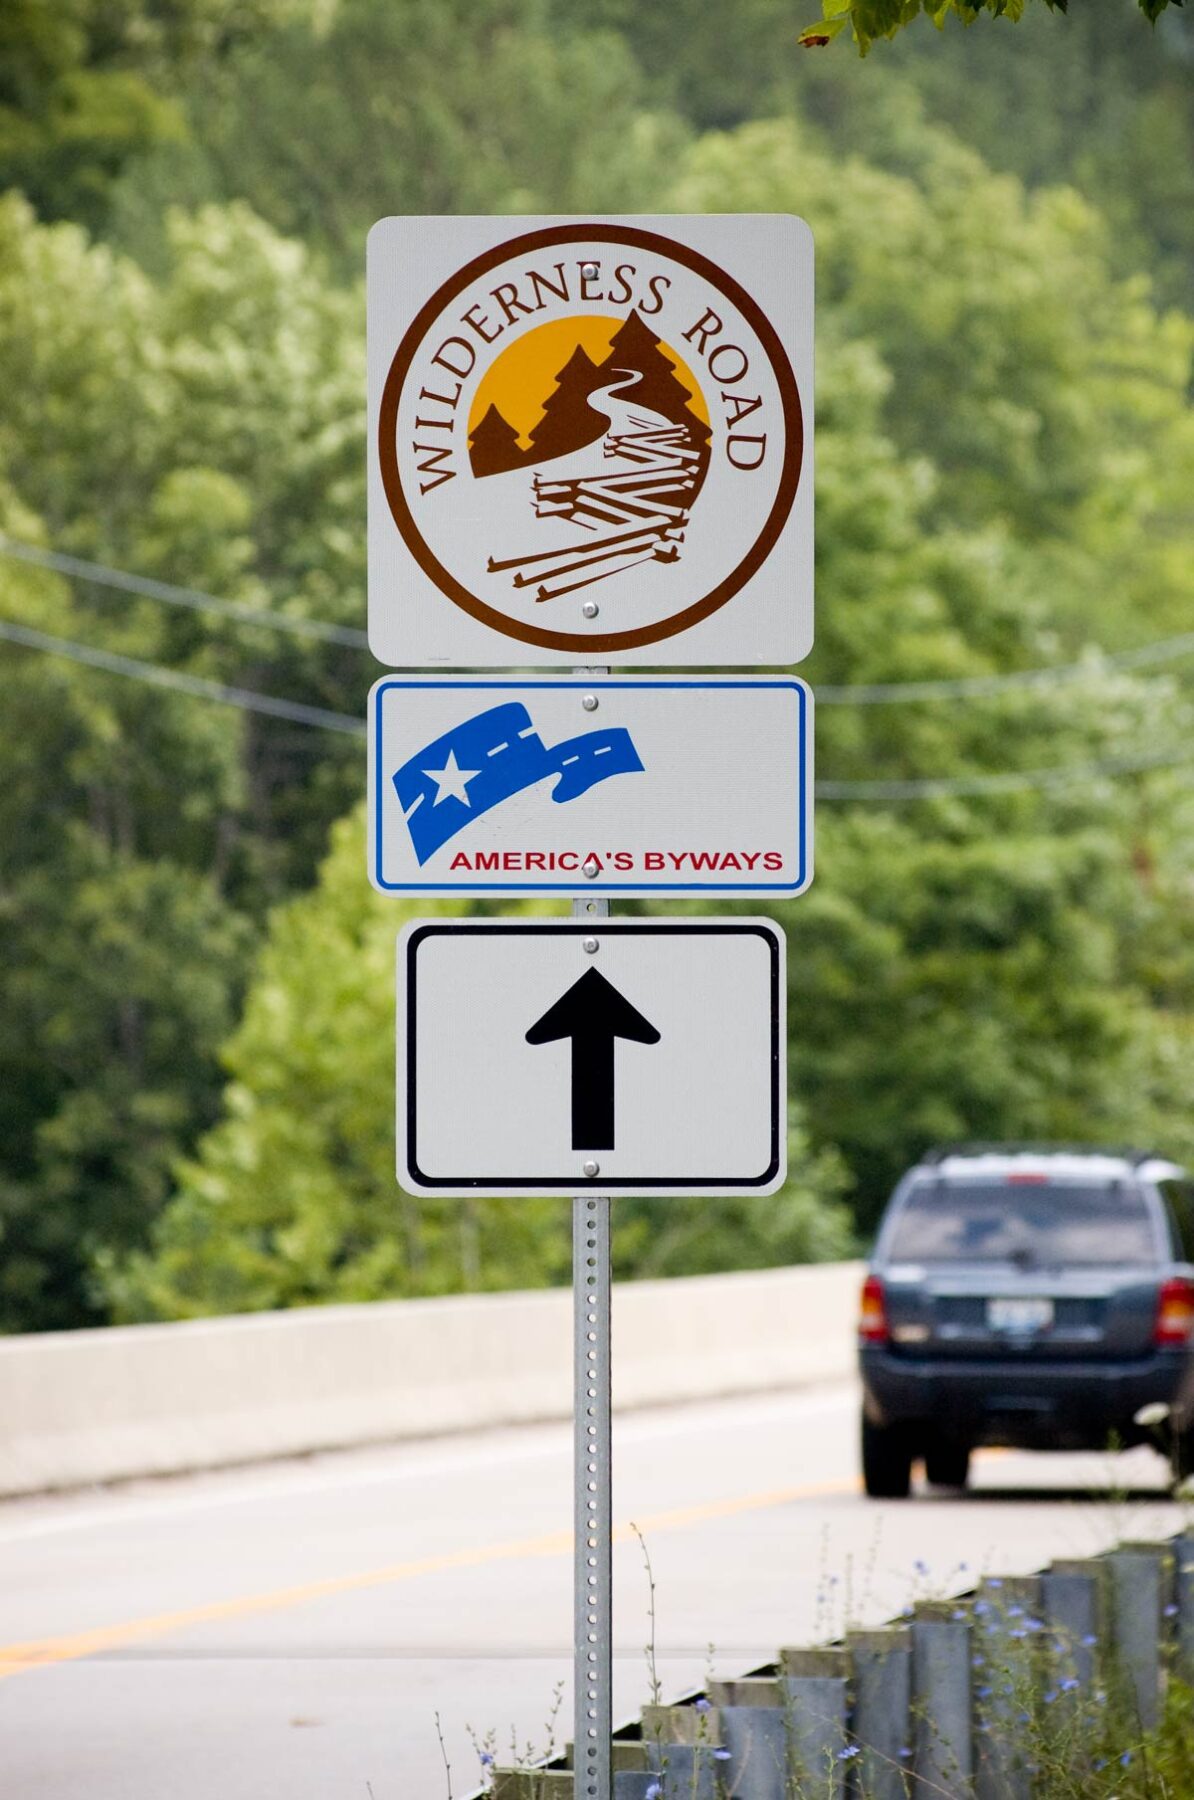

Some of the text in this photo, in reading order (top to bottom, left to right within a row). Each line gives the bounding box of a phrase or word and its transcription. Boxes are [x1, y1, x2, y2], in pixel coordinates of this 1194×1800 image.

[412, 261, 767, 496] WILDERNESS ROAD
[450, 852, 784, 870] AMERICA'S BYWAYS
